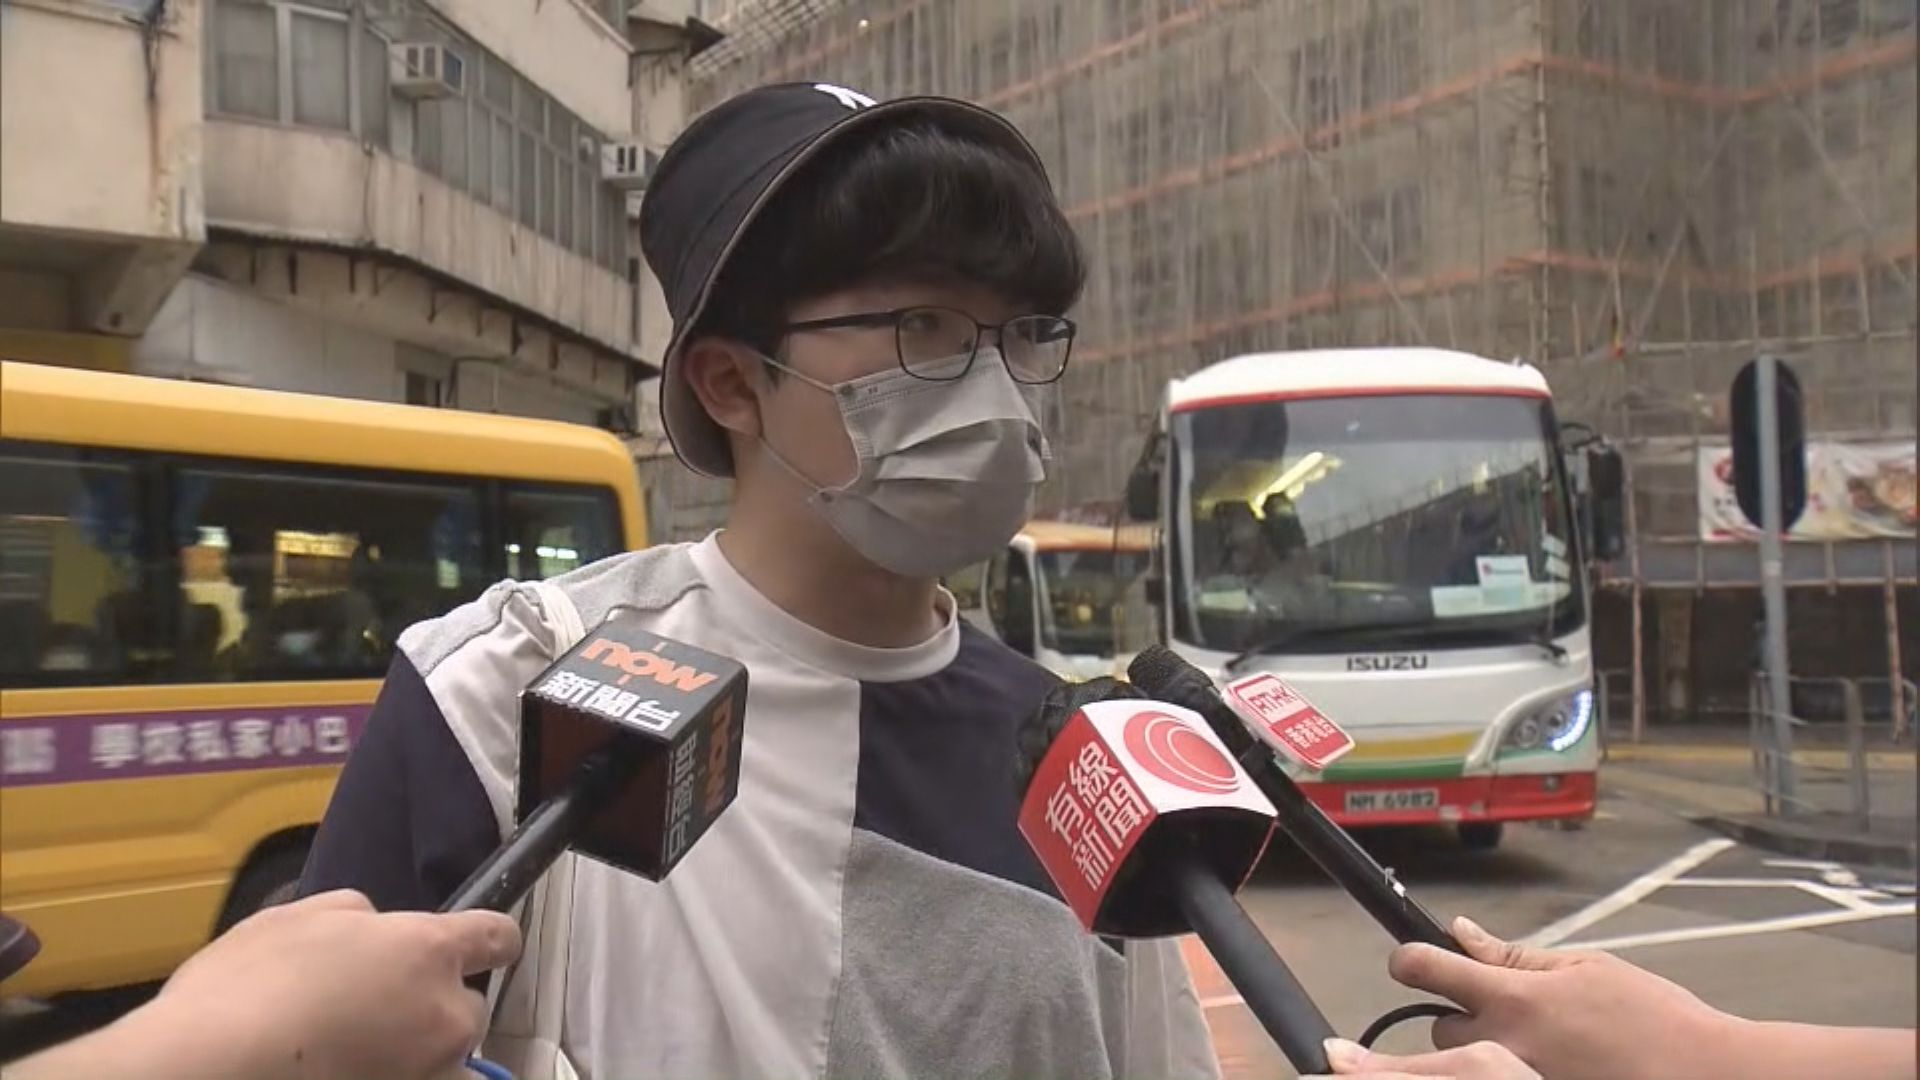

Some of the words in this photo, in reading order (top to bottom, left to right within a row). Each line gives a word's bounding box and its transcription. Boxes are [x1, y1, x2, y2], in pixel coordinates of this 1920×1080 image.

[580, 638, 718, 691] now
[1346, 655, 1428, 672] ISUZU
[537, 670, 681, 731] 新聞台
[1247, 687, 1297, 715] RTHK
[1045, 741, 1118, 846] 有線
[1072, 776, 1149, 891] 新聞
